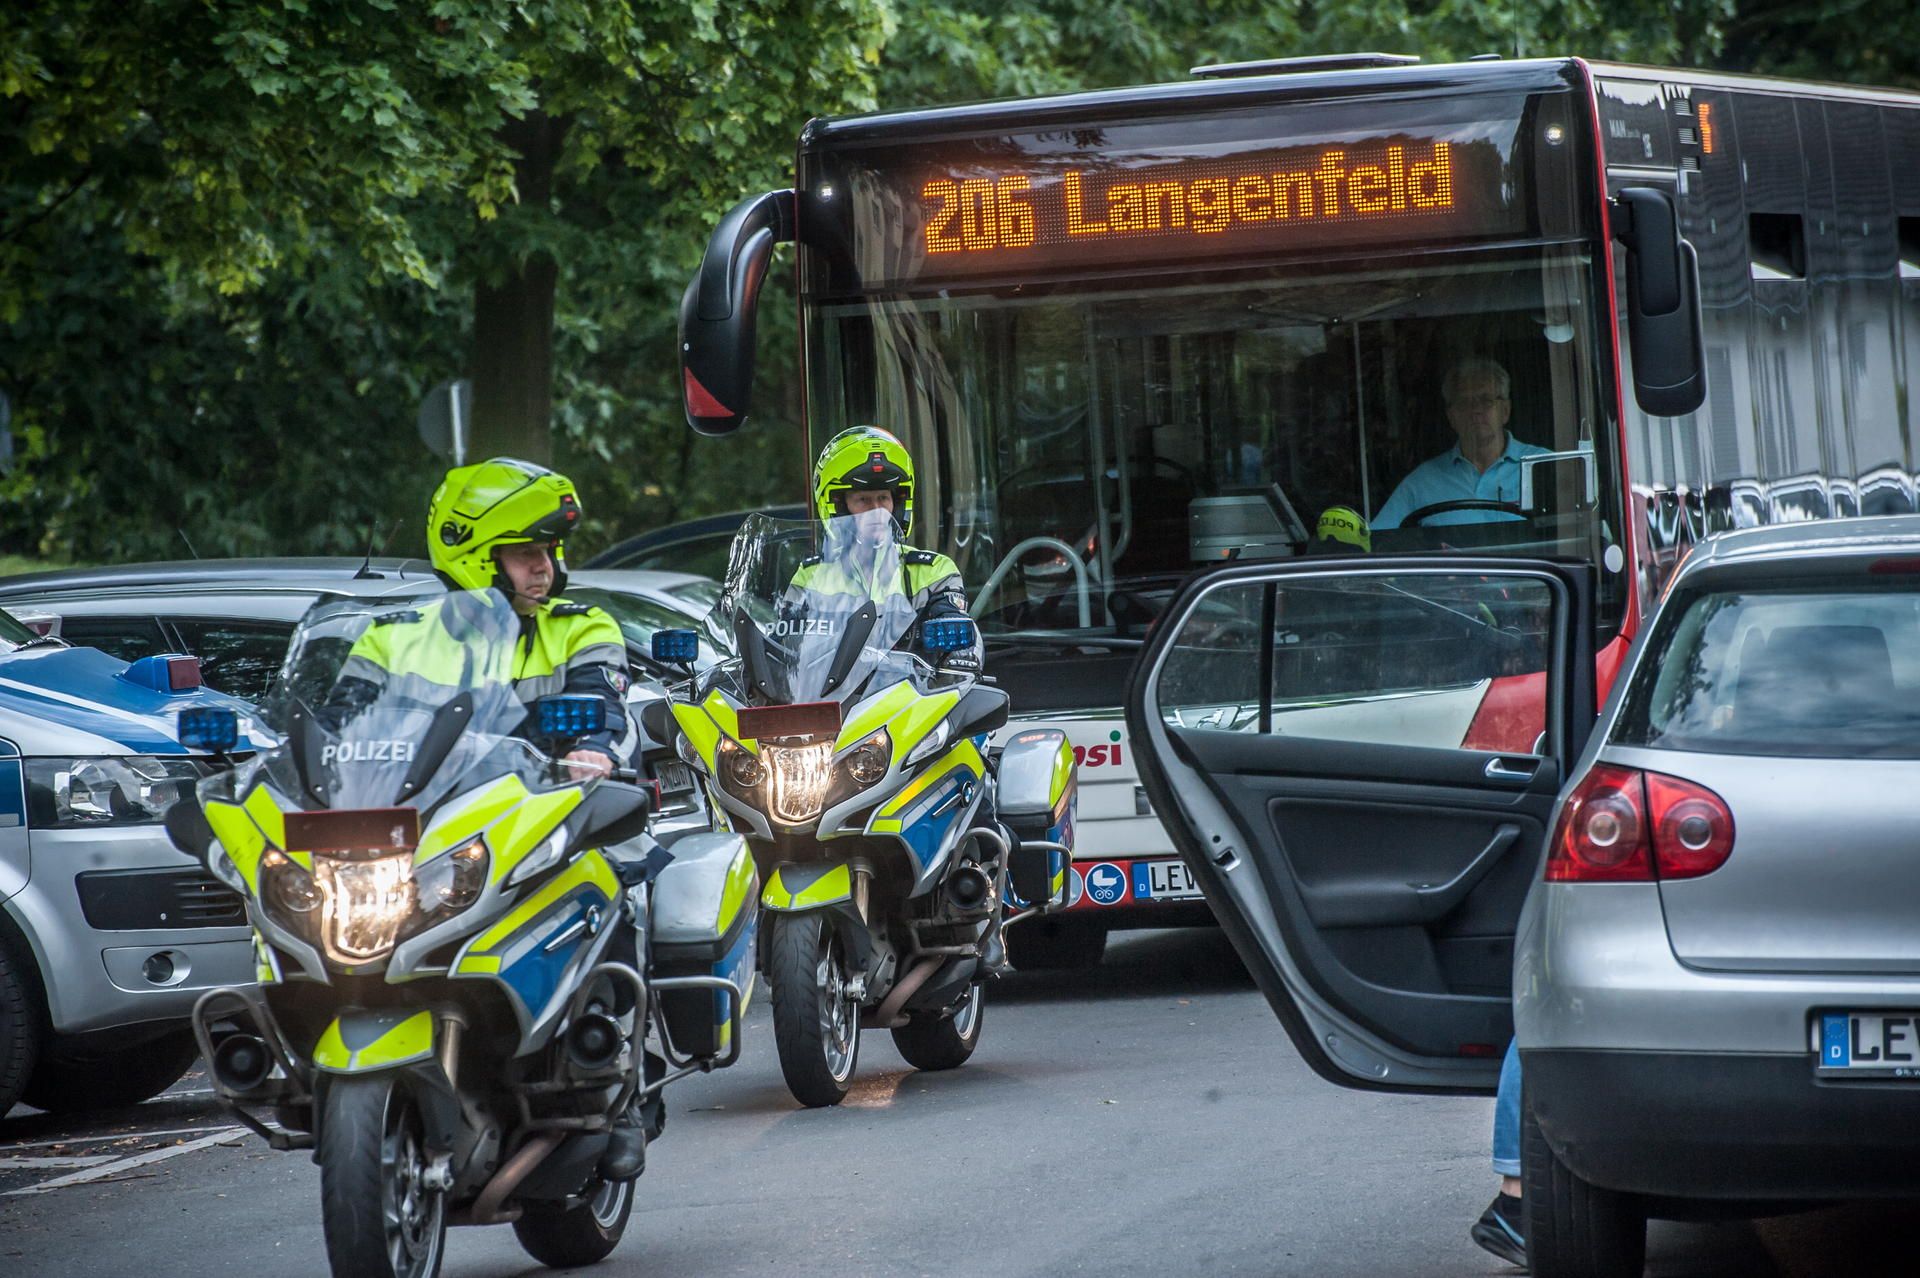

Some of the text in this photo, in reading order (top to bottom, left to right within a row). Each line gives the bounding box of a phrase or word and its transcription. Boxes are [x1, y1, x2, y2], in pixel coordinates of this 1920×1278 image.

[922, 142, 1453, 253] 206 Langenfeld
[765, 619, 835, 637] POLIZEI
[321, 740, 415, 766] POLIZEI
[1831, 1018, 1920, 1061] D LE
